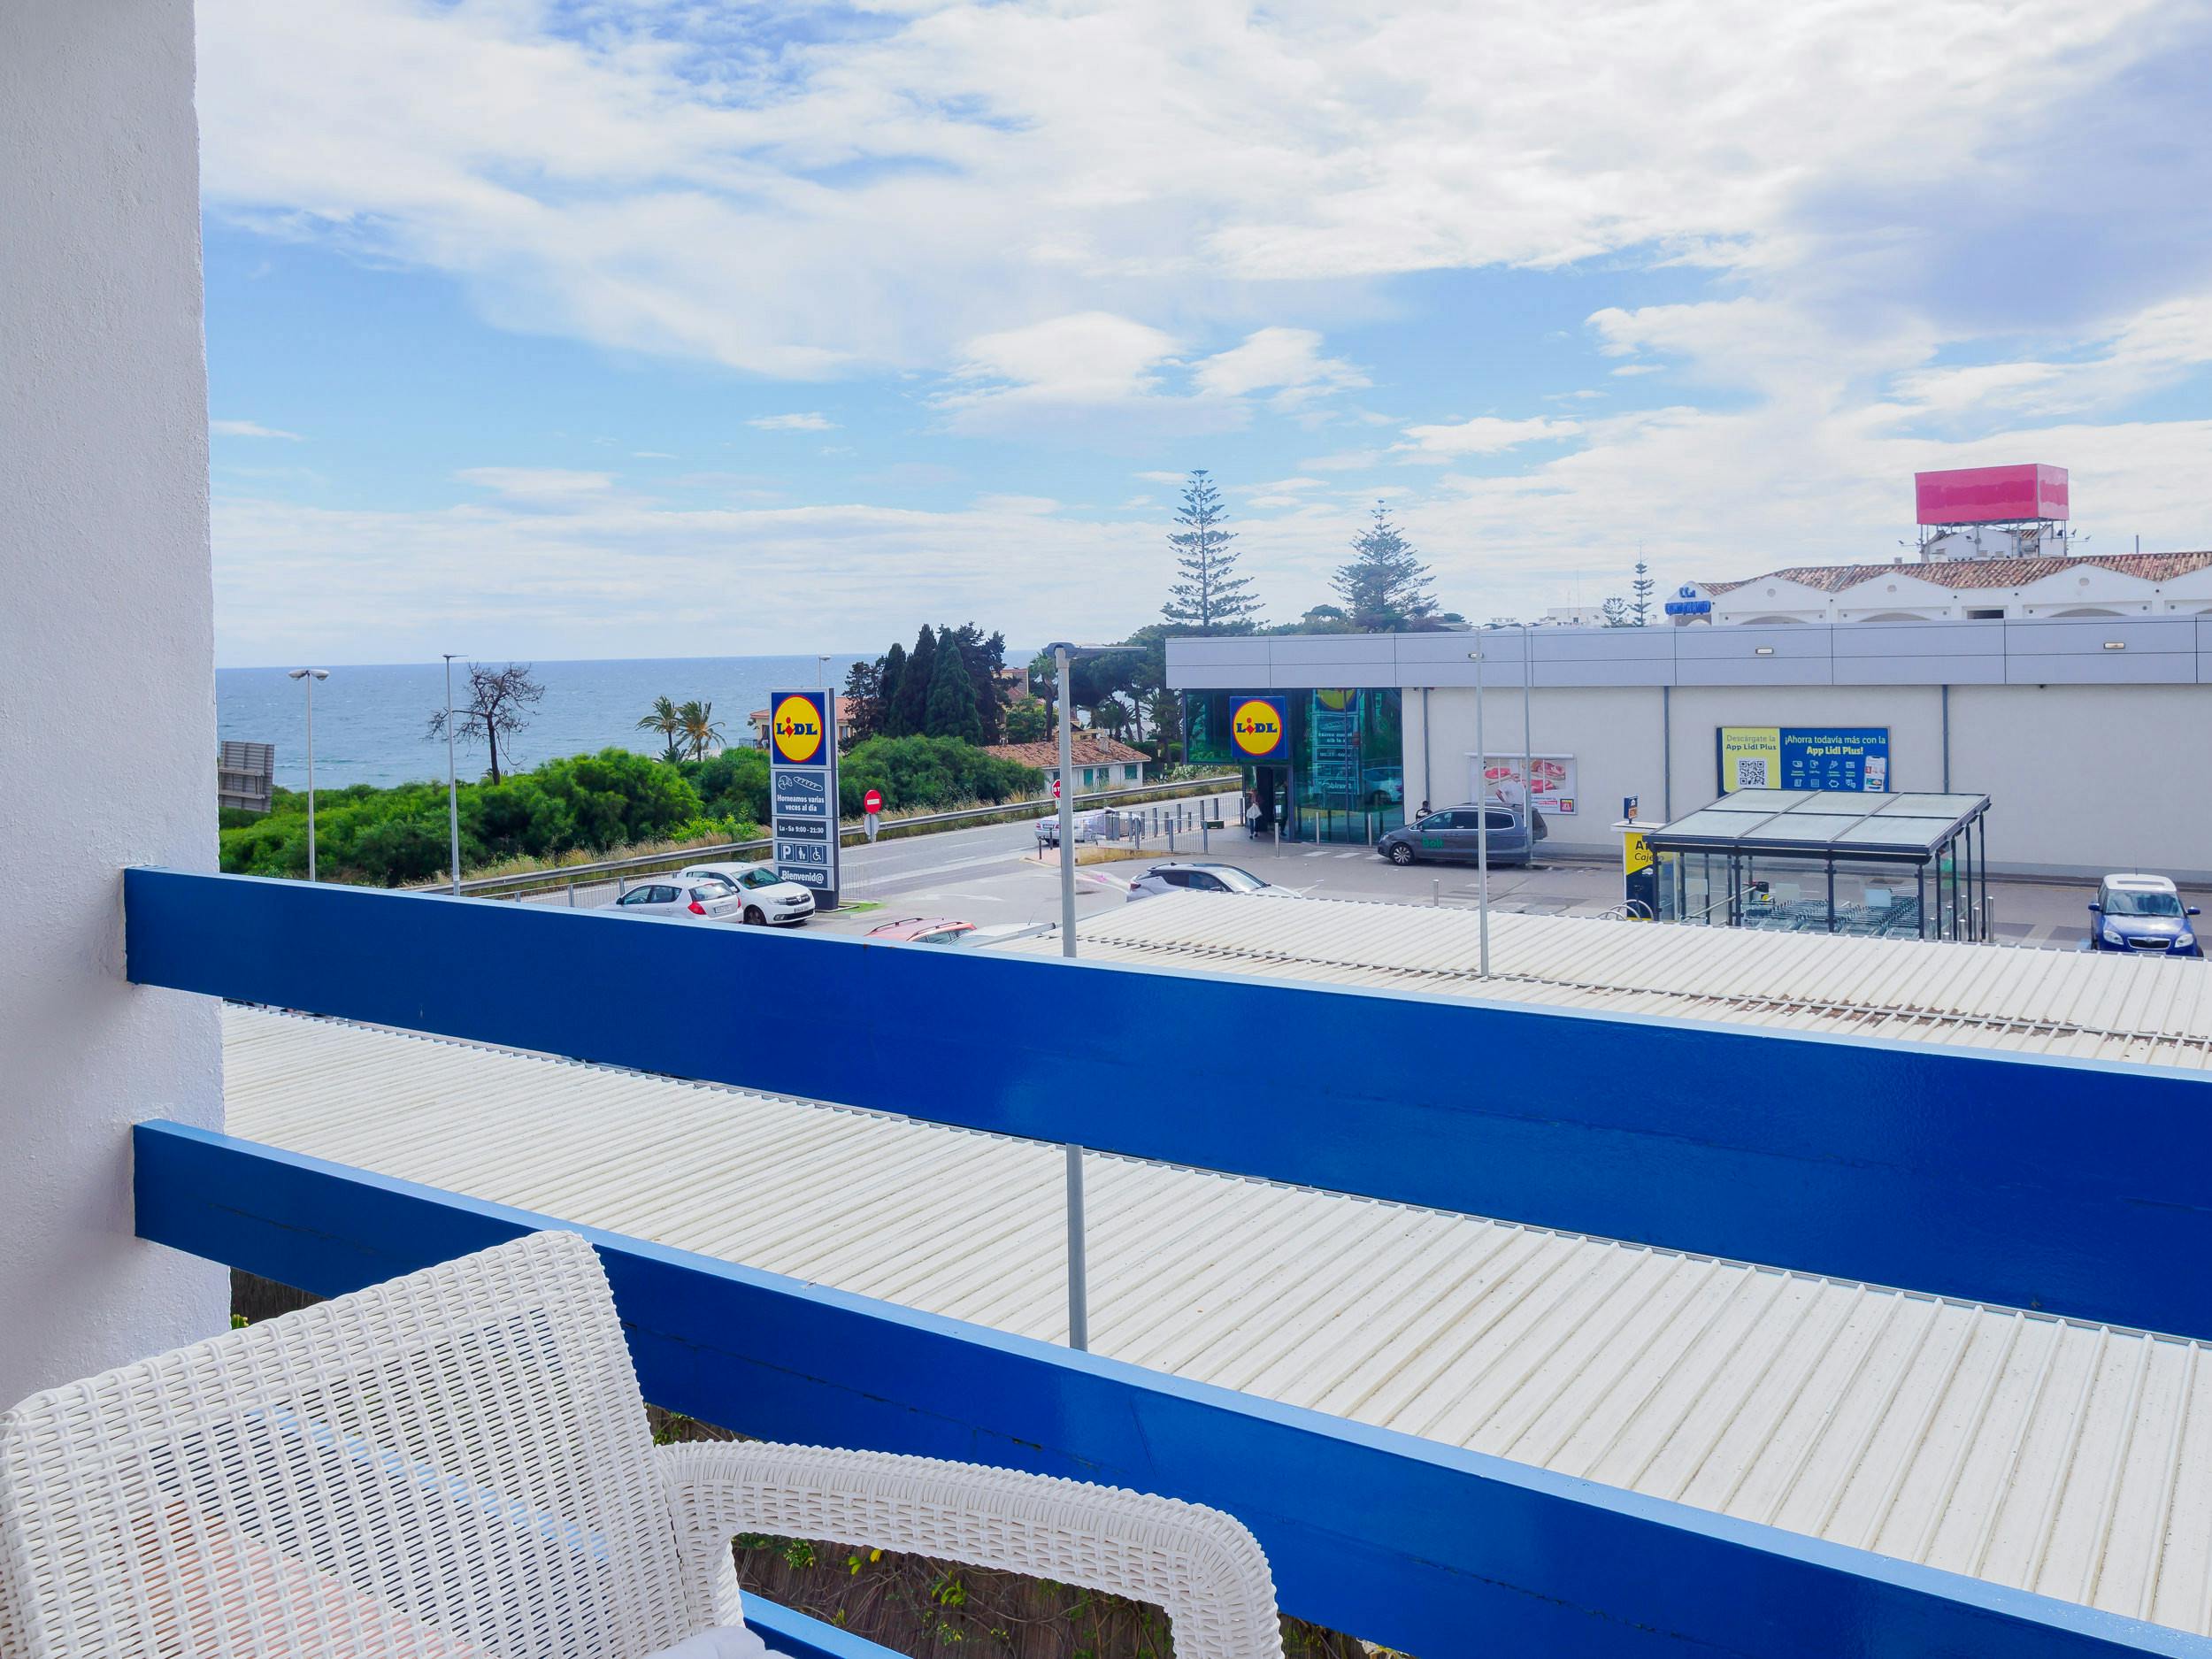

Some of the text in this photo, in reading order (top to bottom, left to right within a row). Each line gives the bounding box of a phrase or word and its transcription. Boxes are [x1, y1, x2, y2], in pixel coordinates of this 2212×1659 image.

[1785, 734, 1812, 745] ¡Ahorra
[1814, 735, 1842, 744] todavía
[1878, 735, 1886, 744] la
[1806, 746, 1863, 757] App Lidl Plus!
[777, 794, 807, 803] Horneamos
[781, 870, 825, 884] Bienvenid@
